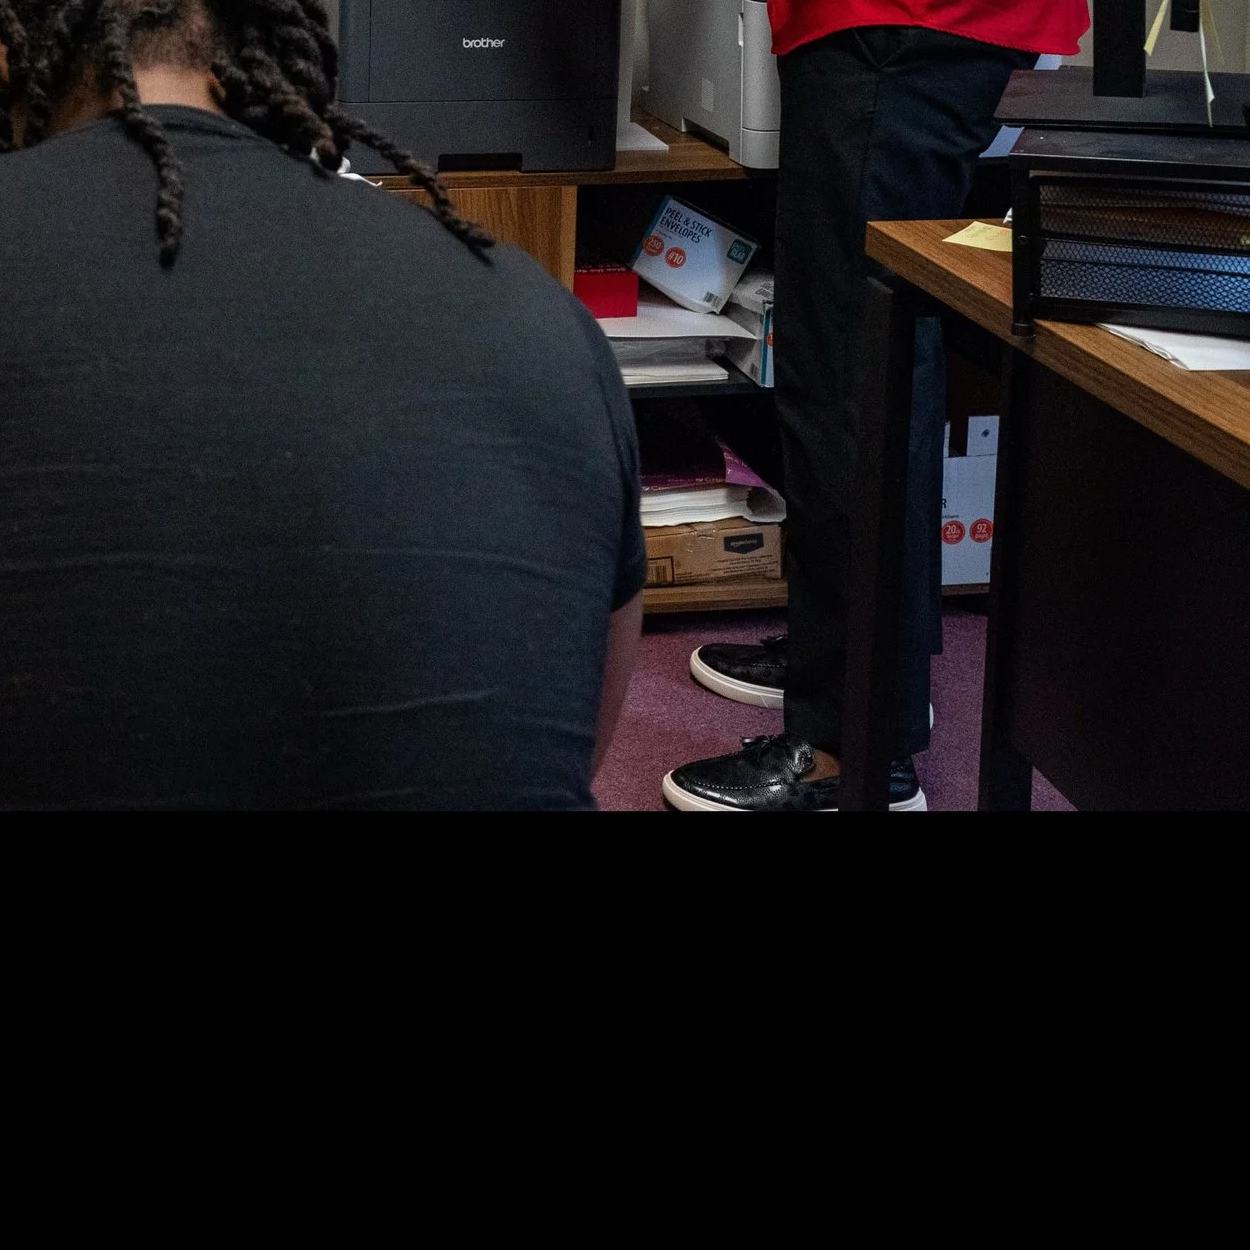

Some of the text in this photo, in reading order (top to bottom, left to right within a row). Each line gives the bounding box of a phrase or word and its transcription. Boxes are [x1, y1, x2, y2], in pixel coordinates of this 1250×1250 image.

[462, 38, 505, 48] brother
[660, 216, 701, 243] ENVELOPES
[664, 207, 712, 238] PEEL & STICK
[668, 251, 684, 265] #10
[976, 523, 987, 533] 92
